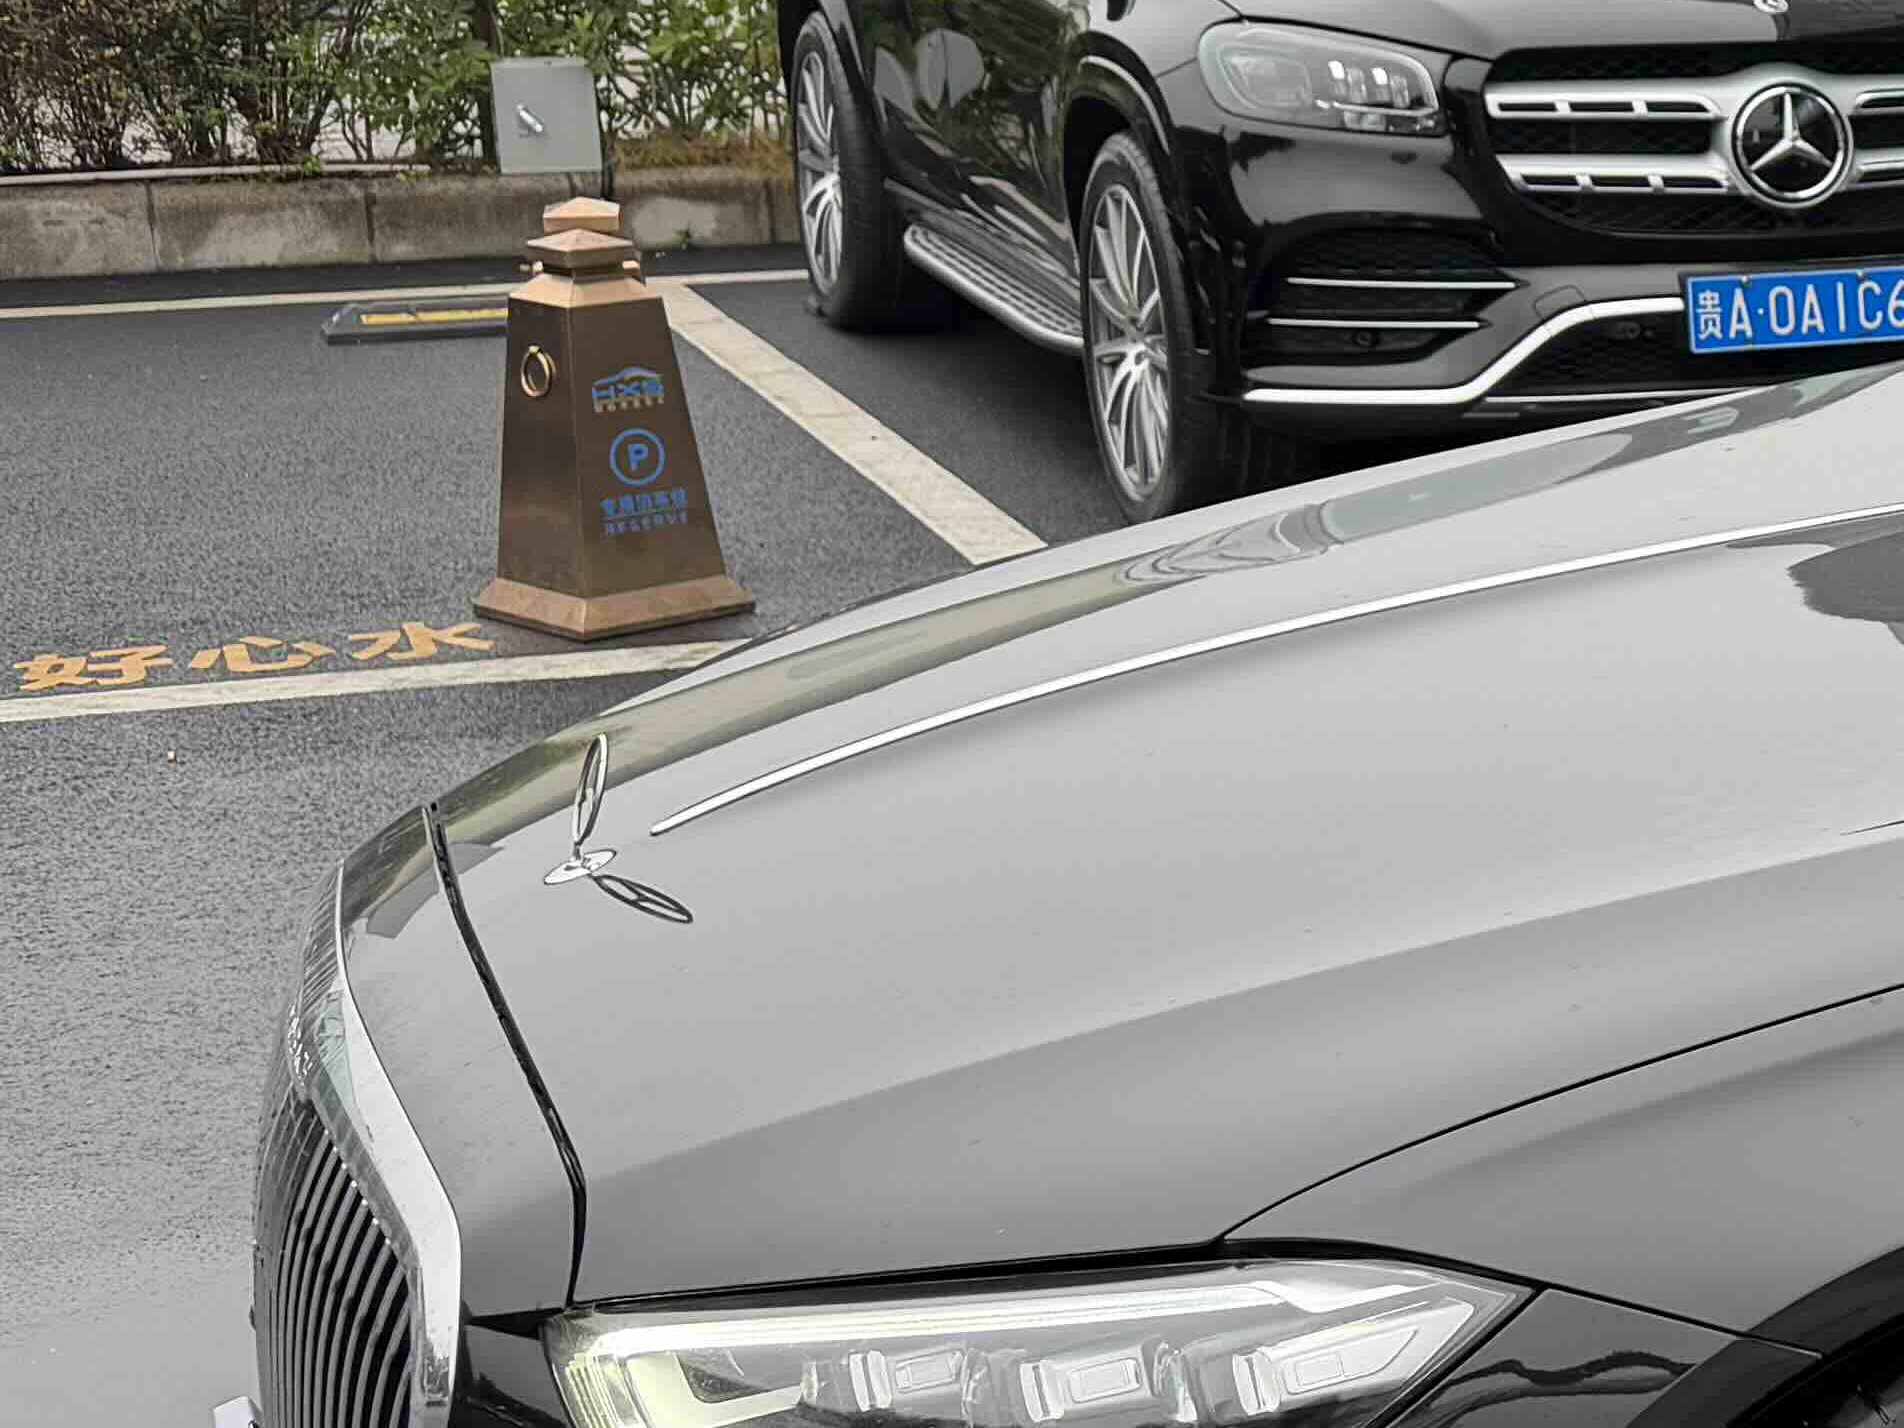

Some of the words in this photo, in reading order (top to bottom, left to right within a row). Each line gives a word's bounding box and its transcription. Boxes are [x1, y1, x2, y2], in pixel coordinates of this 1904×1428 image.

[627, 442, 649, 471] P
[13, 621, 496, 691] 好心水
